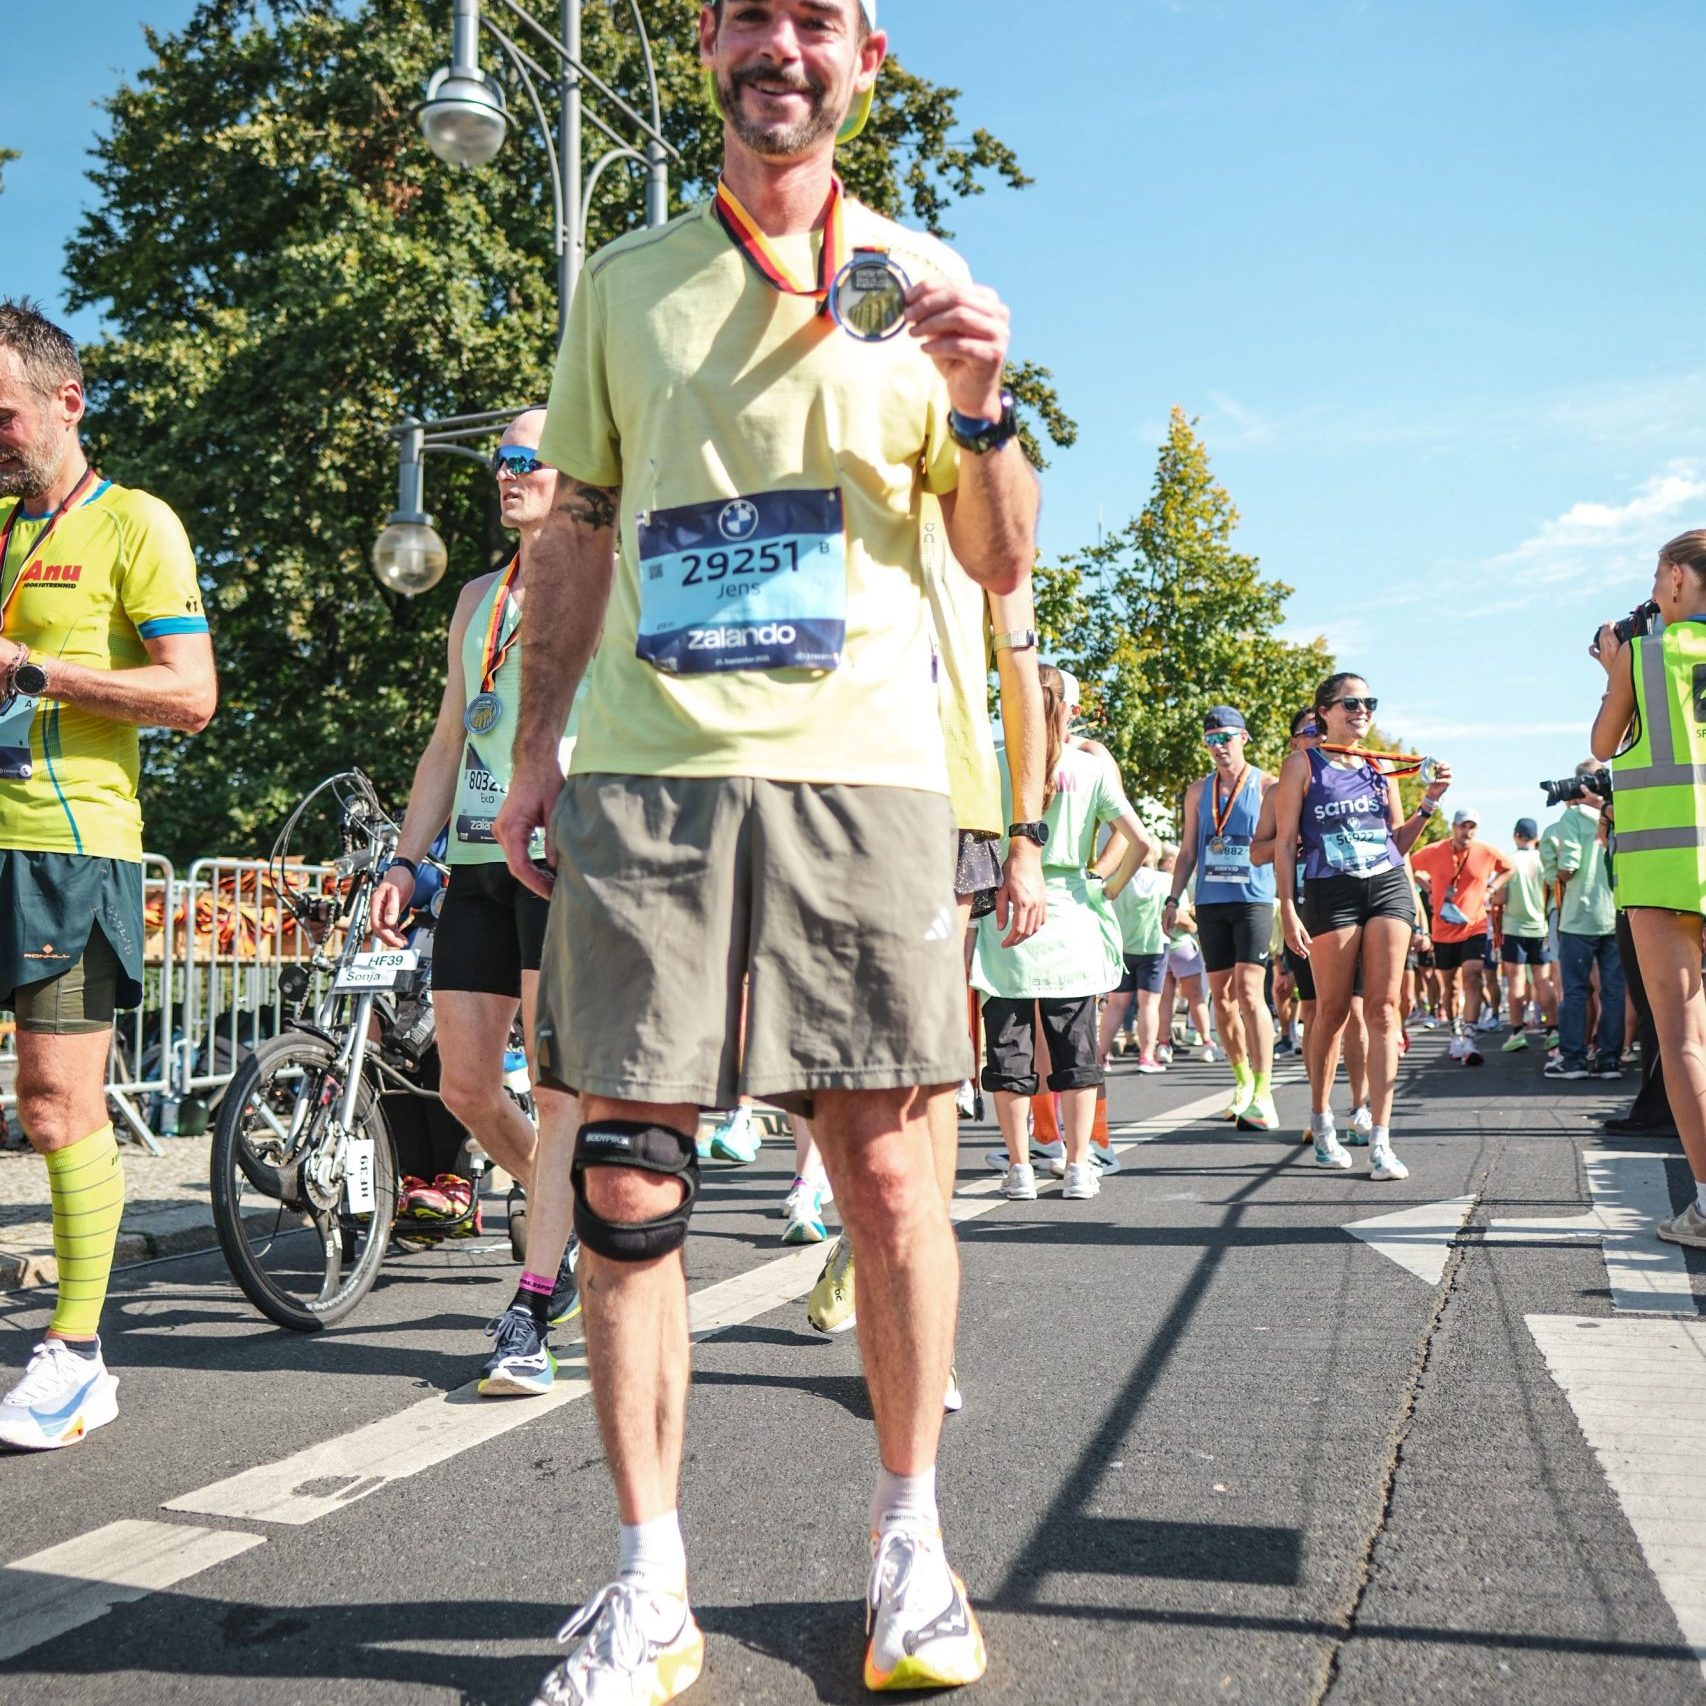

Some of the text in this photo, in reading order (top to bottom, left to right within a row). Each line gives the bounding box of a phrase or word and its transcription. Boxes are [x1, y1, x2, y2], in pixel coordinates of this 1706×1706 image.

[21, 560, 82, 581] Anu
[681, 540, 799, 587] 29251
[716, 581, 761, 600] Jens
[688, 623, 796, 650] zalando
[25, 700, 33, 709] A
[1314, 794, 1380, 820] sands
[368, 955, 404, 968] HF39
[346, 971, 381, 983] Sonja
